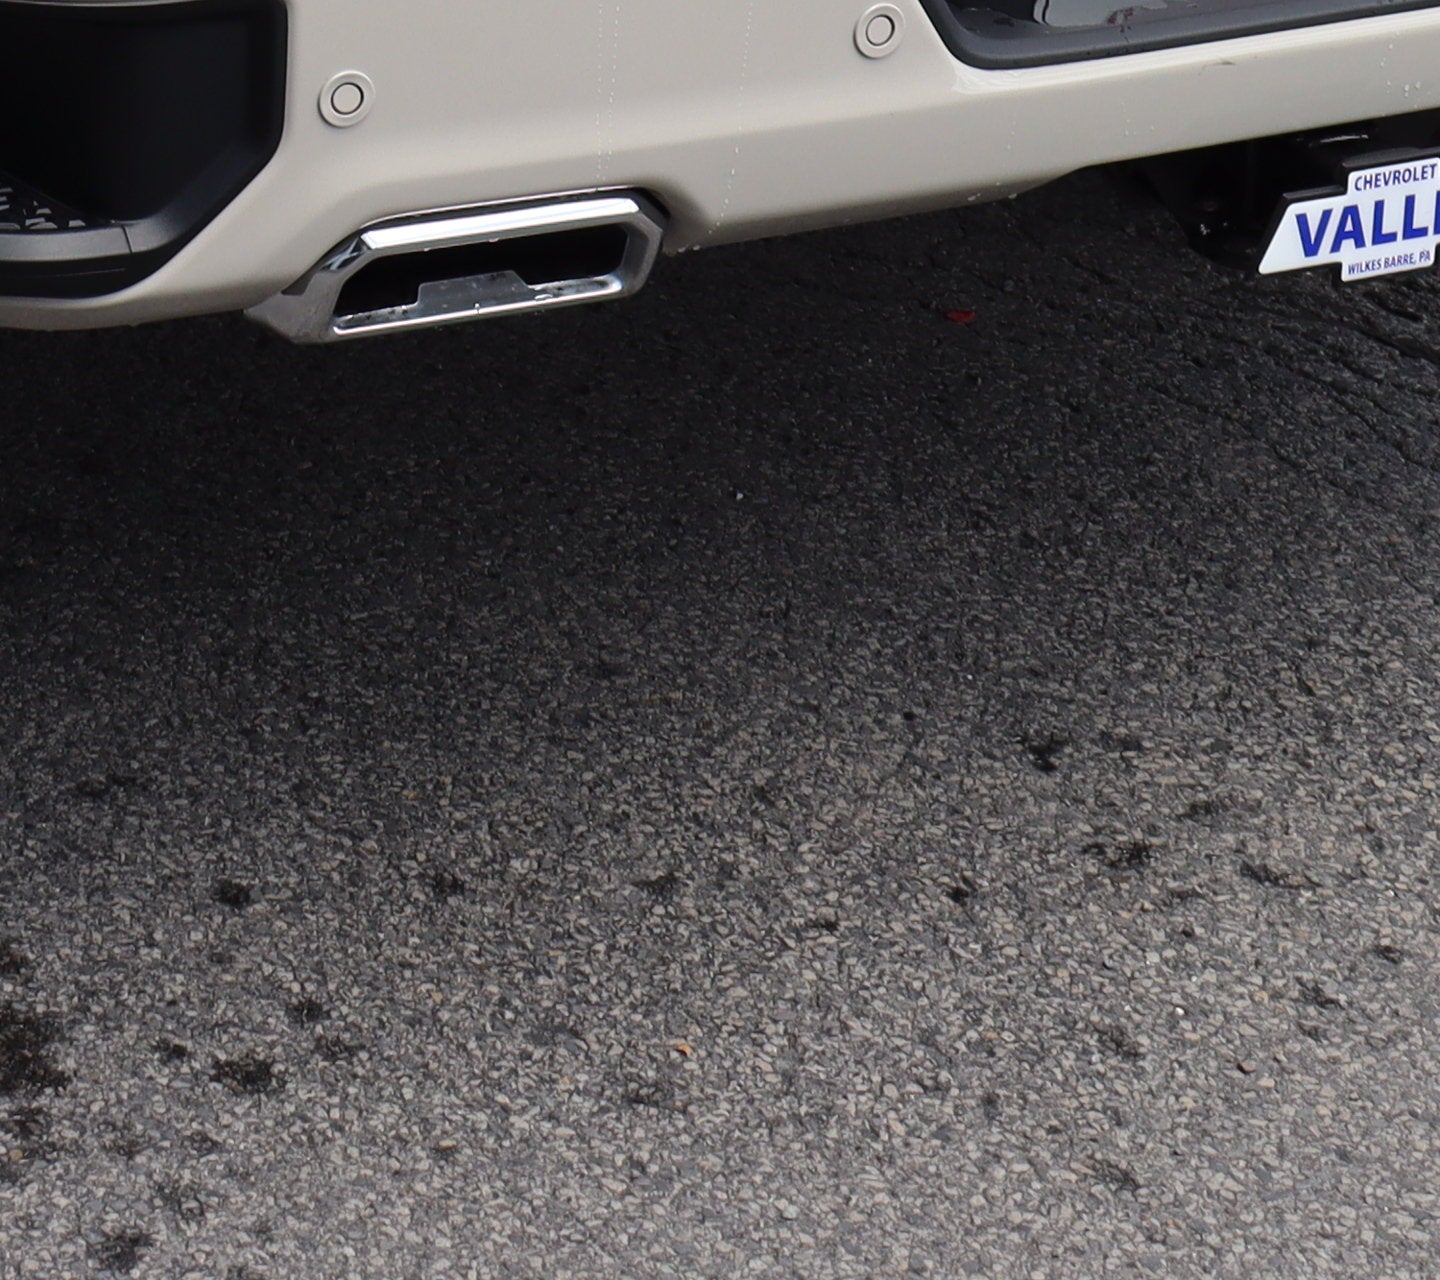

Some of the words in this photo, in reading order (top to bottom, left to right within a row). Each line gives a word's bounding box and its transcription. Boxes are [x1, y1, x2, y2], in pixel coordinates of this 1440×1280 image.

[1354, 163, 1438, 192] CHEVROLET
[1348, 255, 1382, 275] WILKES
[1383, 252, 1417, 269] BARRE,
[1419, 249, 1431, 263] PA
